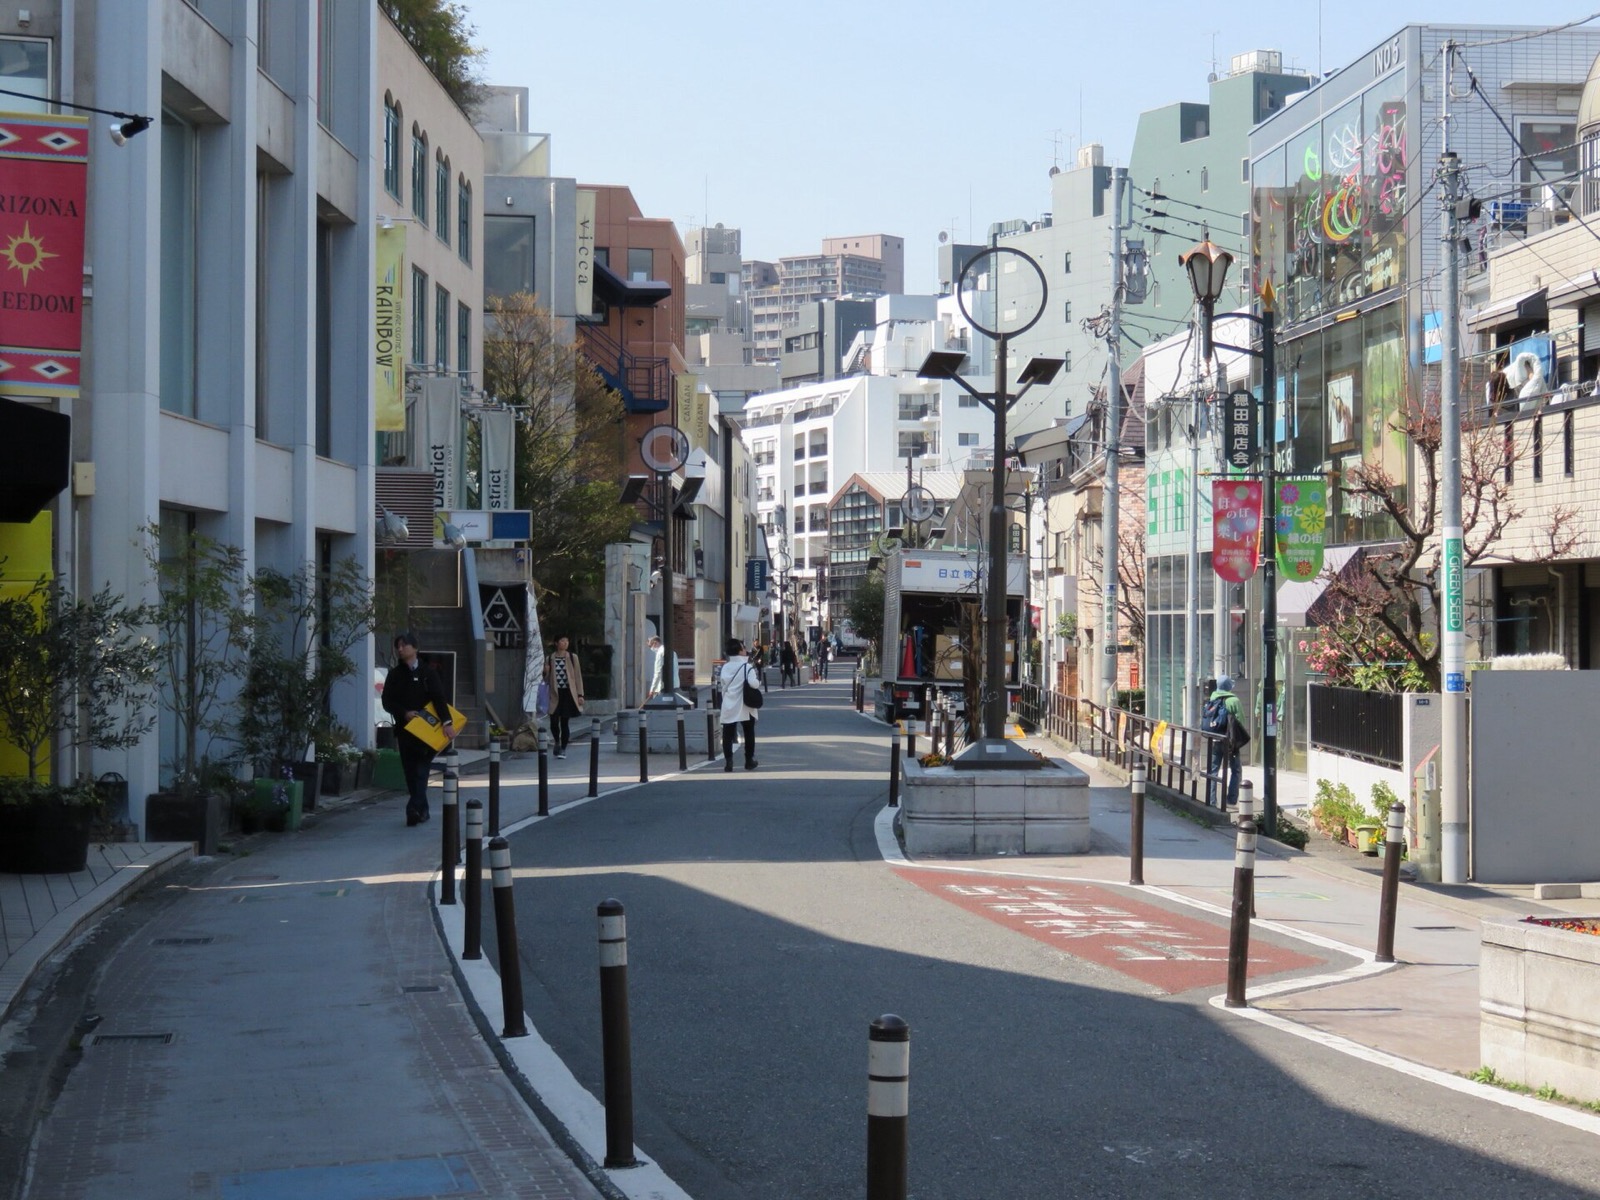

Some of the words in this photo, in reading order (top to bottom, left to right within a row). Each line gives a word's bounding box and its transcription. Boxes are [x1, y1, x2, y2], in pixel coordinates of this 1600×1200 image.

[376, 286, 393, 367] RAINBOW
[683, 384, 691, 422] CANAAN
[1281, 505, 1304, 517] 花と
[1449, 555, 1461, 595] GREEN
[1449, 598, 1461, 628] SEED
